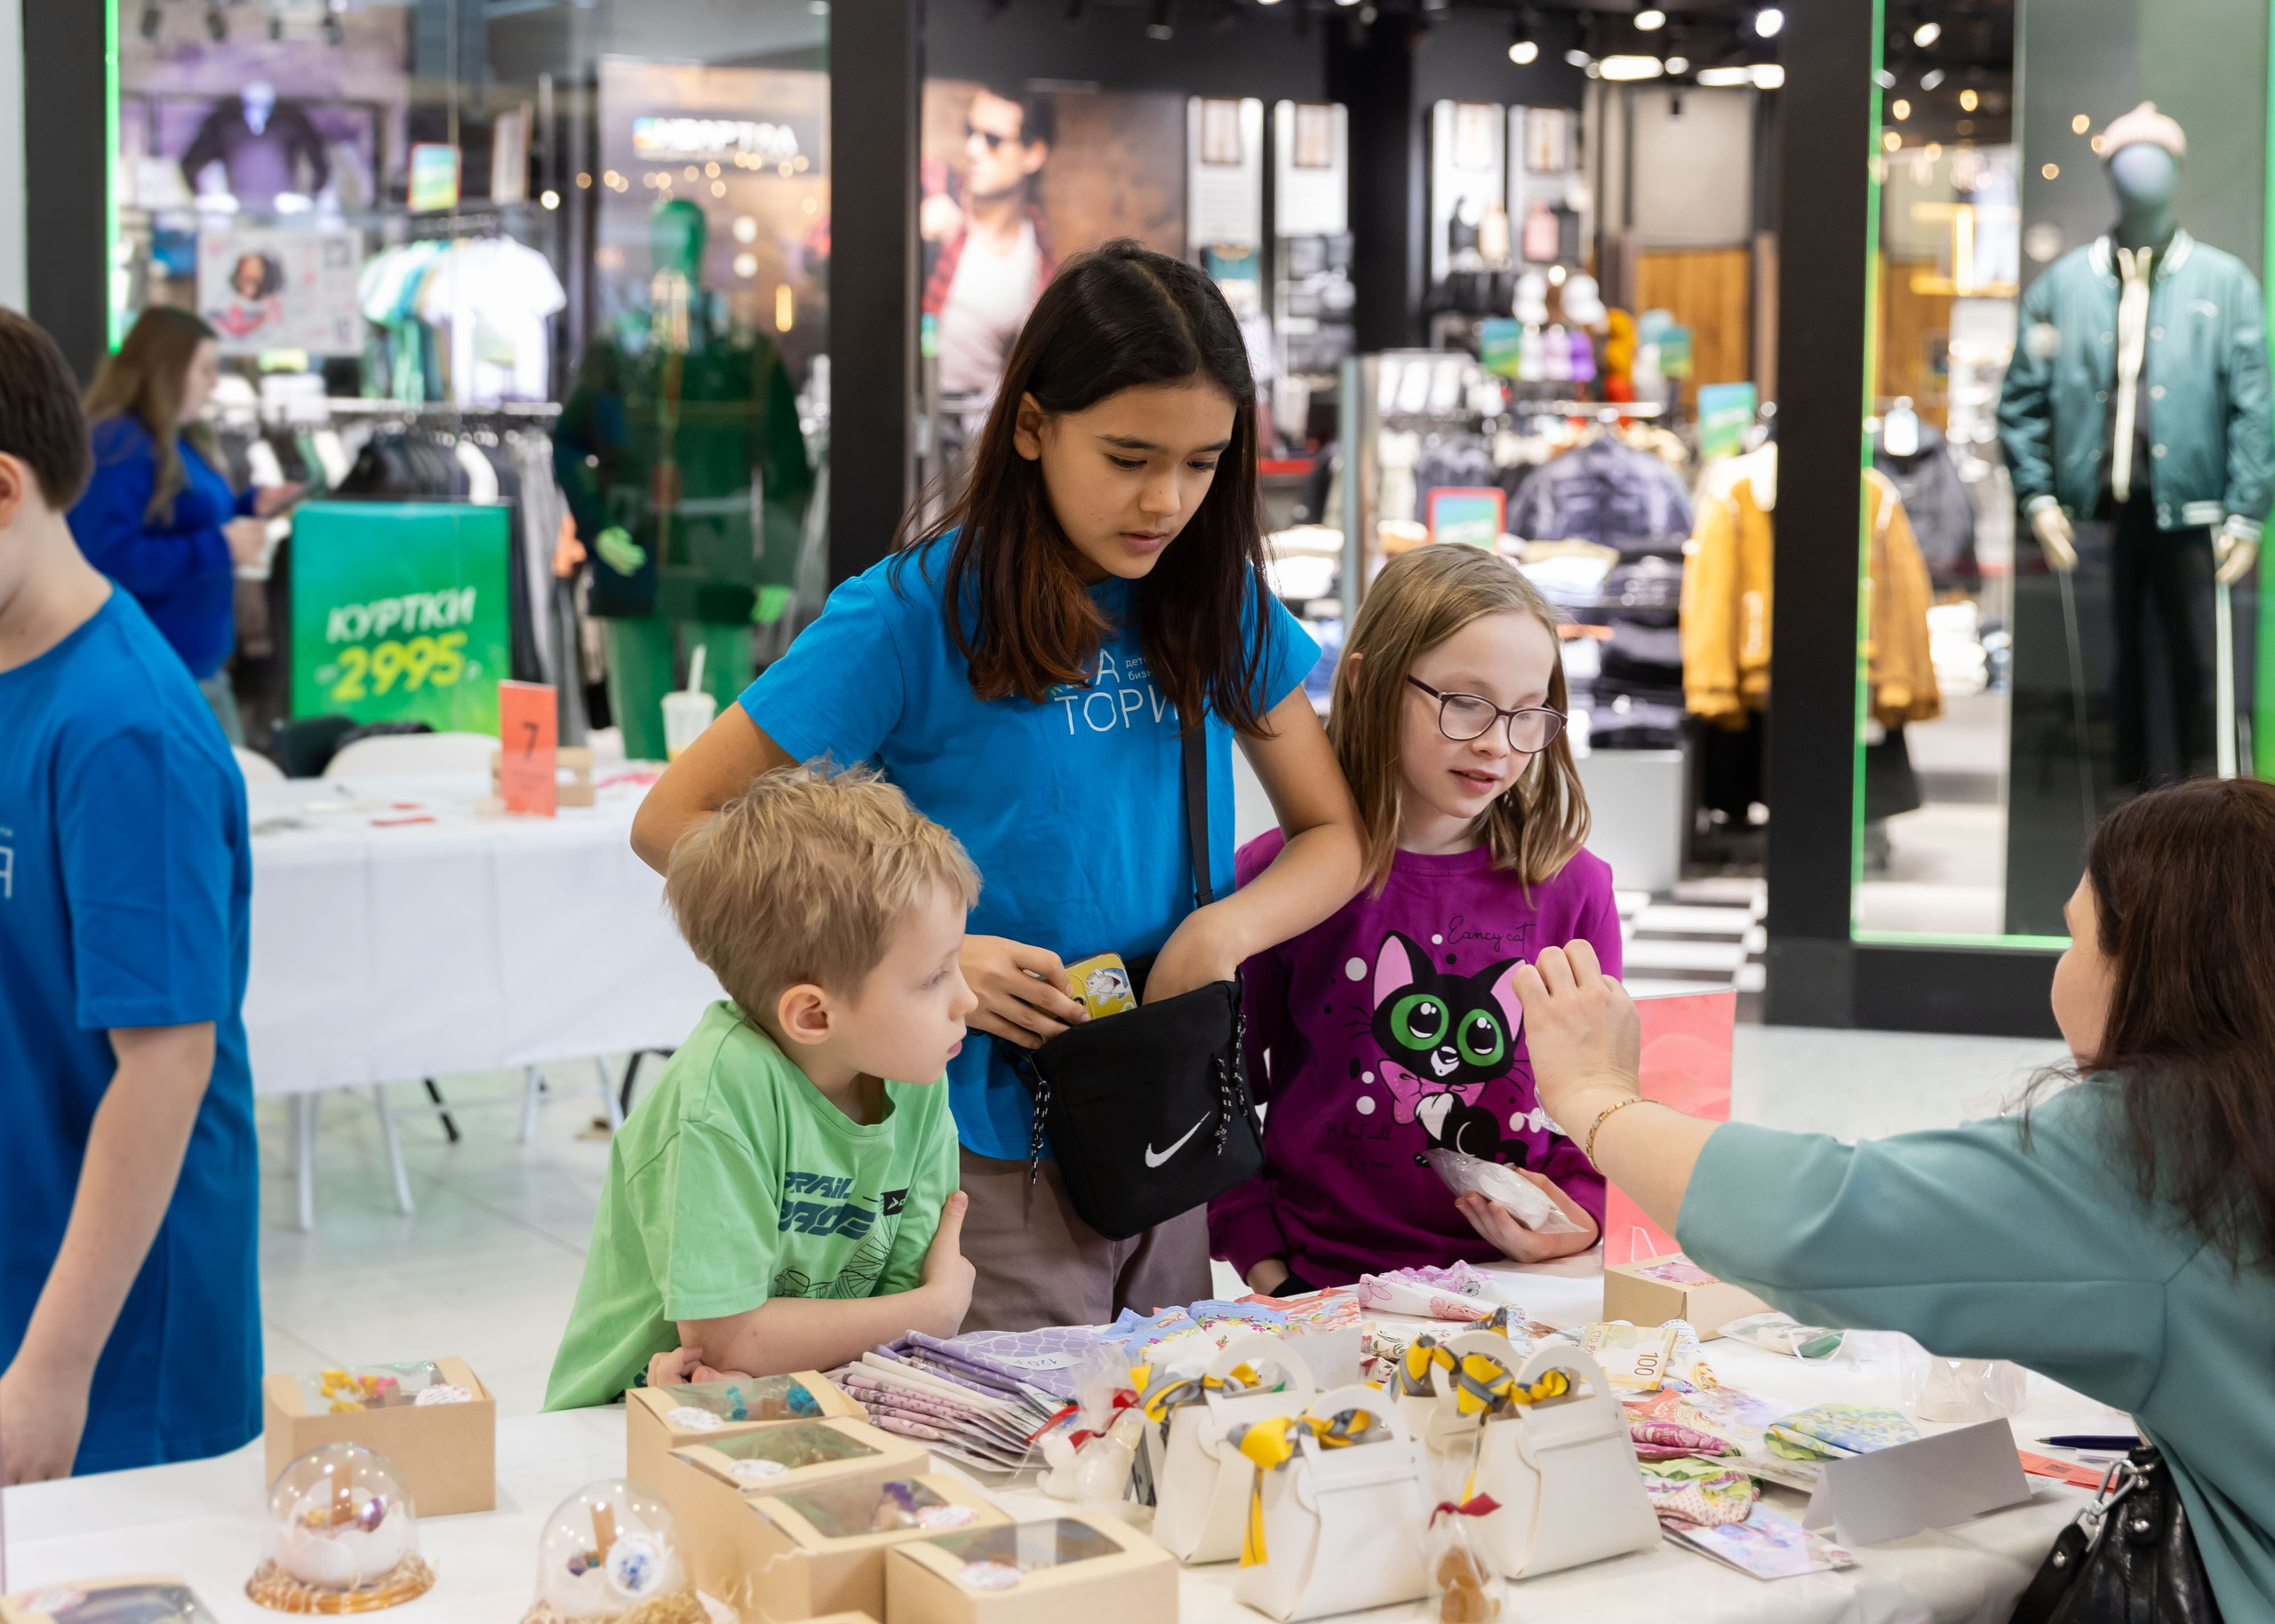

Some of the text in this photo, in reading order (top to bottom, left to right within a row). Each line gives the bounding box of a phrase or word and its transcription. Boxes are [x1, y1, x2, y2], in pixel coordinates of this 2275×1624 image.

[326, 586, 476, 644] КУРТКИ
[332, 631, 468, 702] 2995
[523, 720, 539, 762] 7
[1506, 921, 1537, 953] cat
[1590, 1330, 1602, 1343] СТО
[1633, 1352, 1659, 1376] 100
